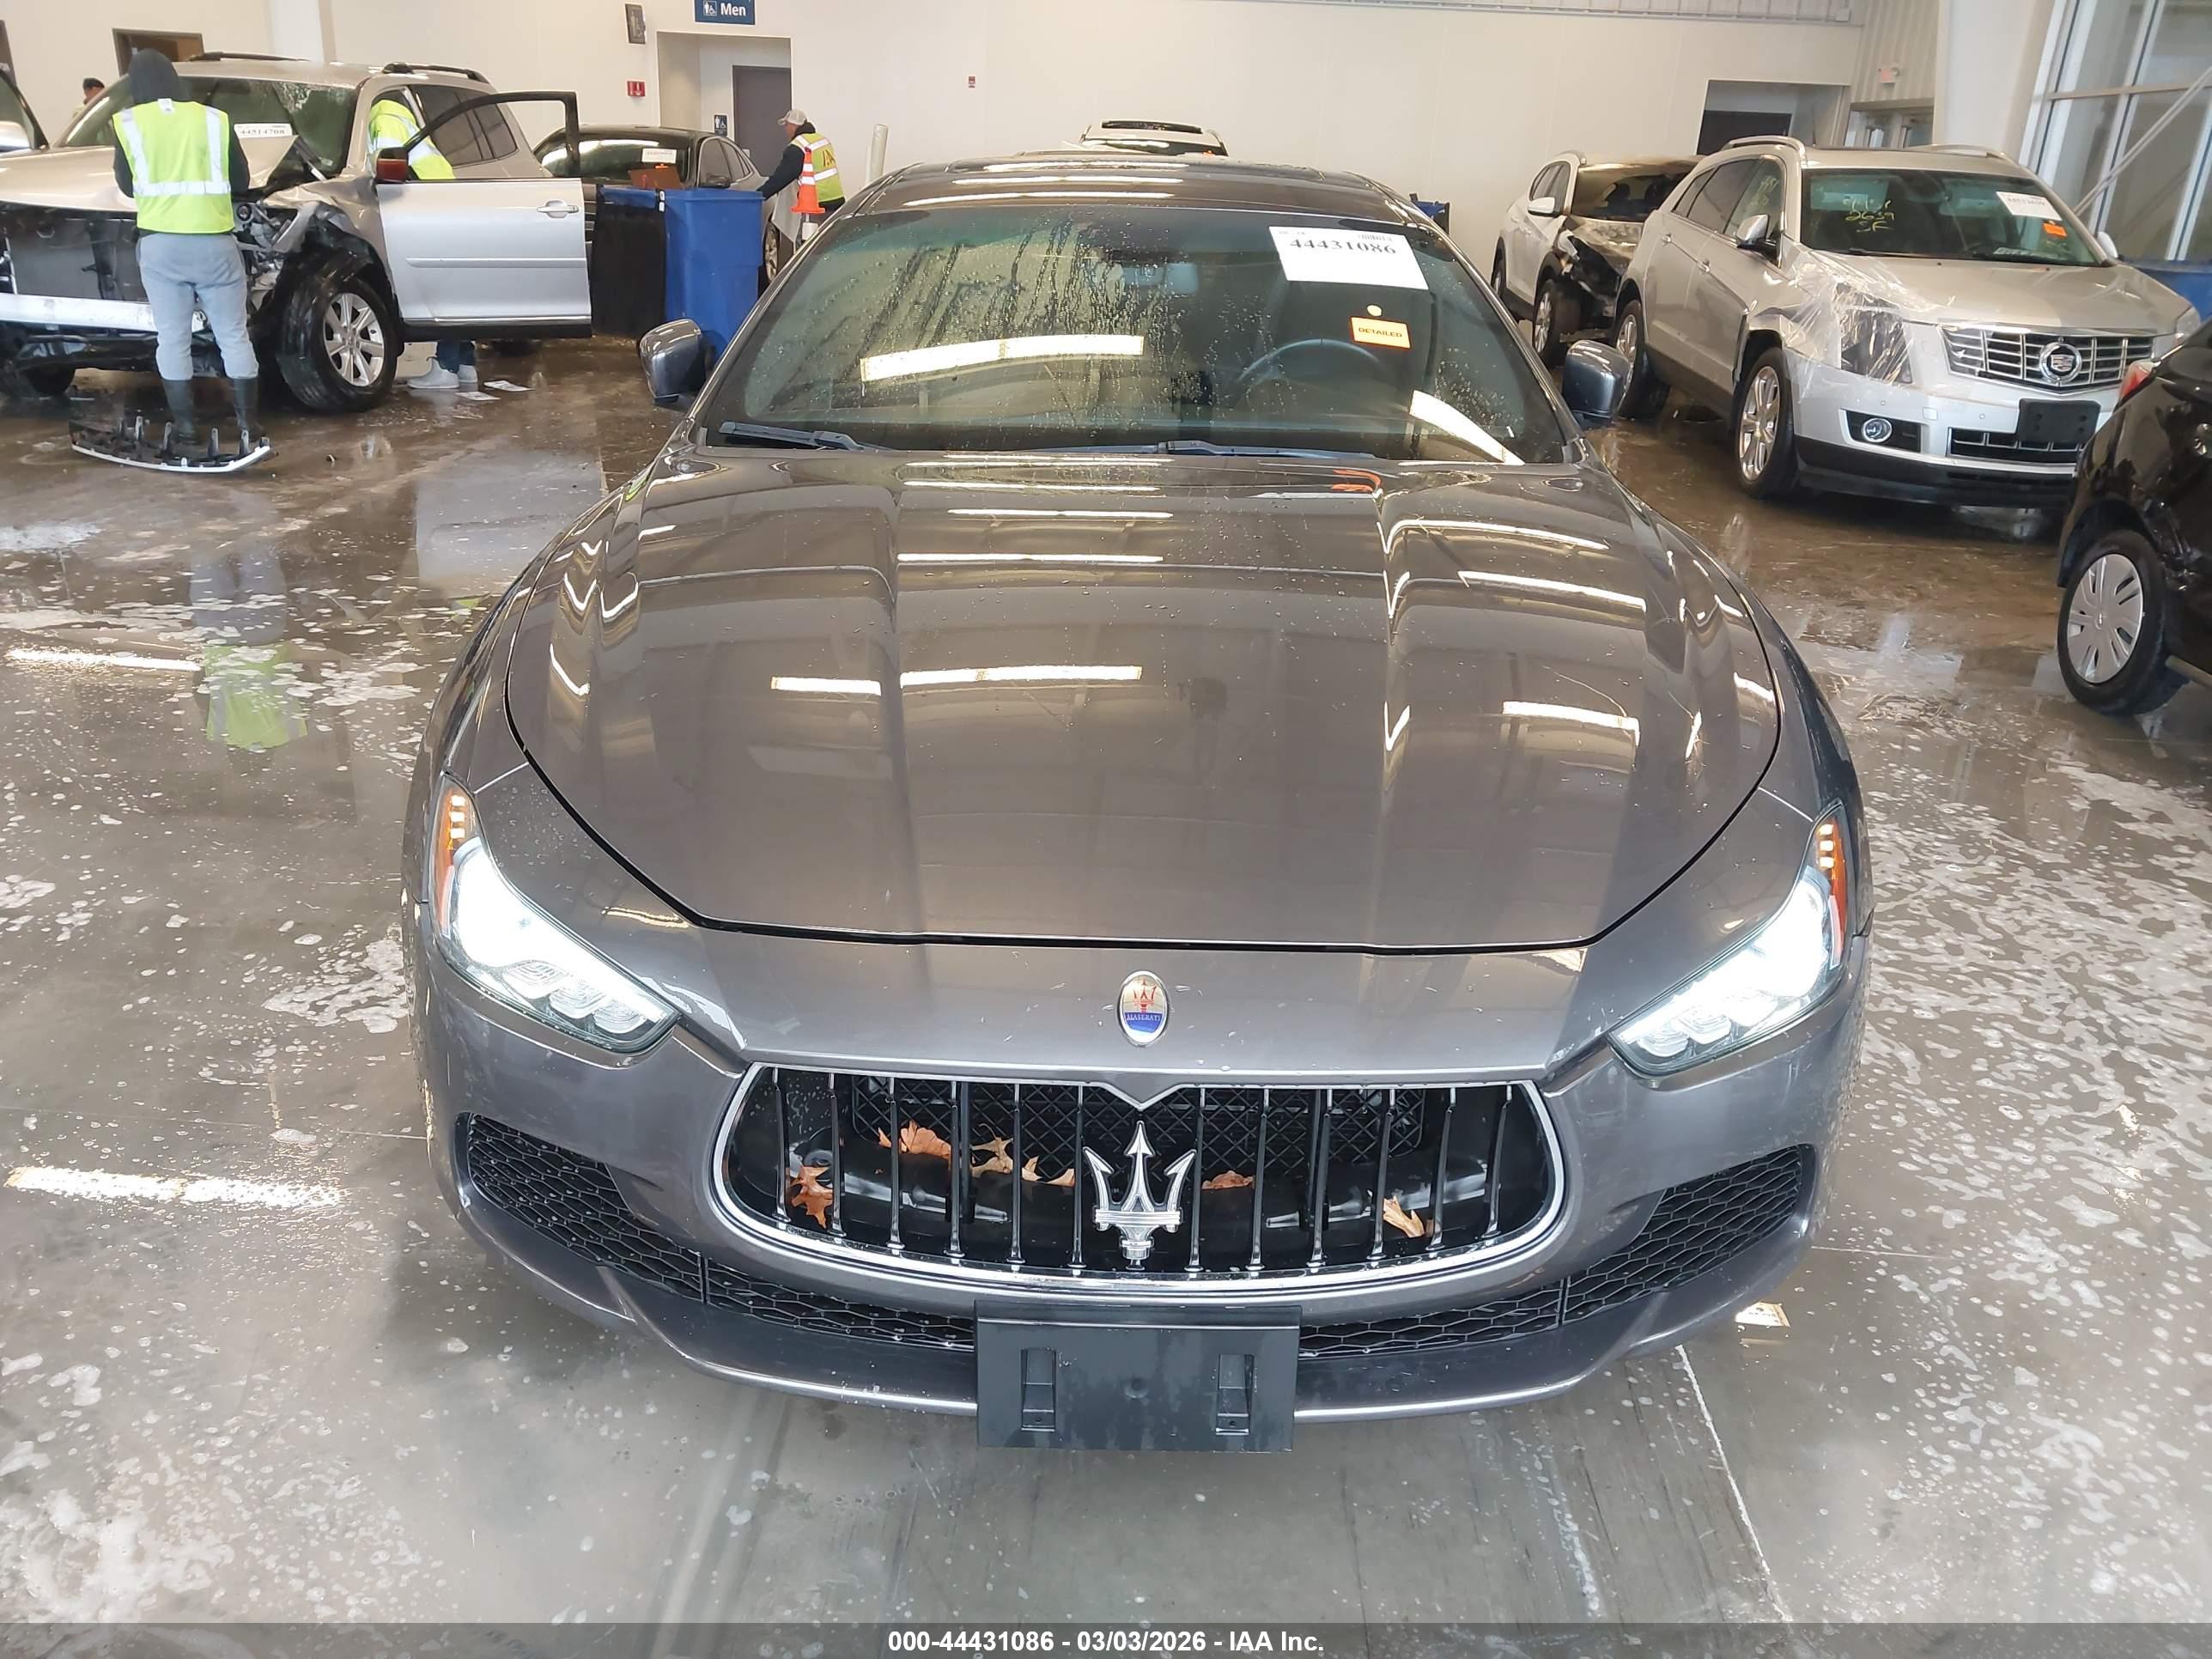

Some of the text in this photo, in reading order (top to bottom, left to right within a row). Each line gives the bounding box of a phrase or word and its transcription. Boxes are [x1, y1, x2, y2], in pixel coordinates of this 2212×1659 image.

[720, 3, 746, 16] Men
[1289, 239, 1397, 255] 44431086
[1358, 327, 1403, 337] DETAILED
[1126, 1013, 1162, 1022] MASERATI
